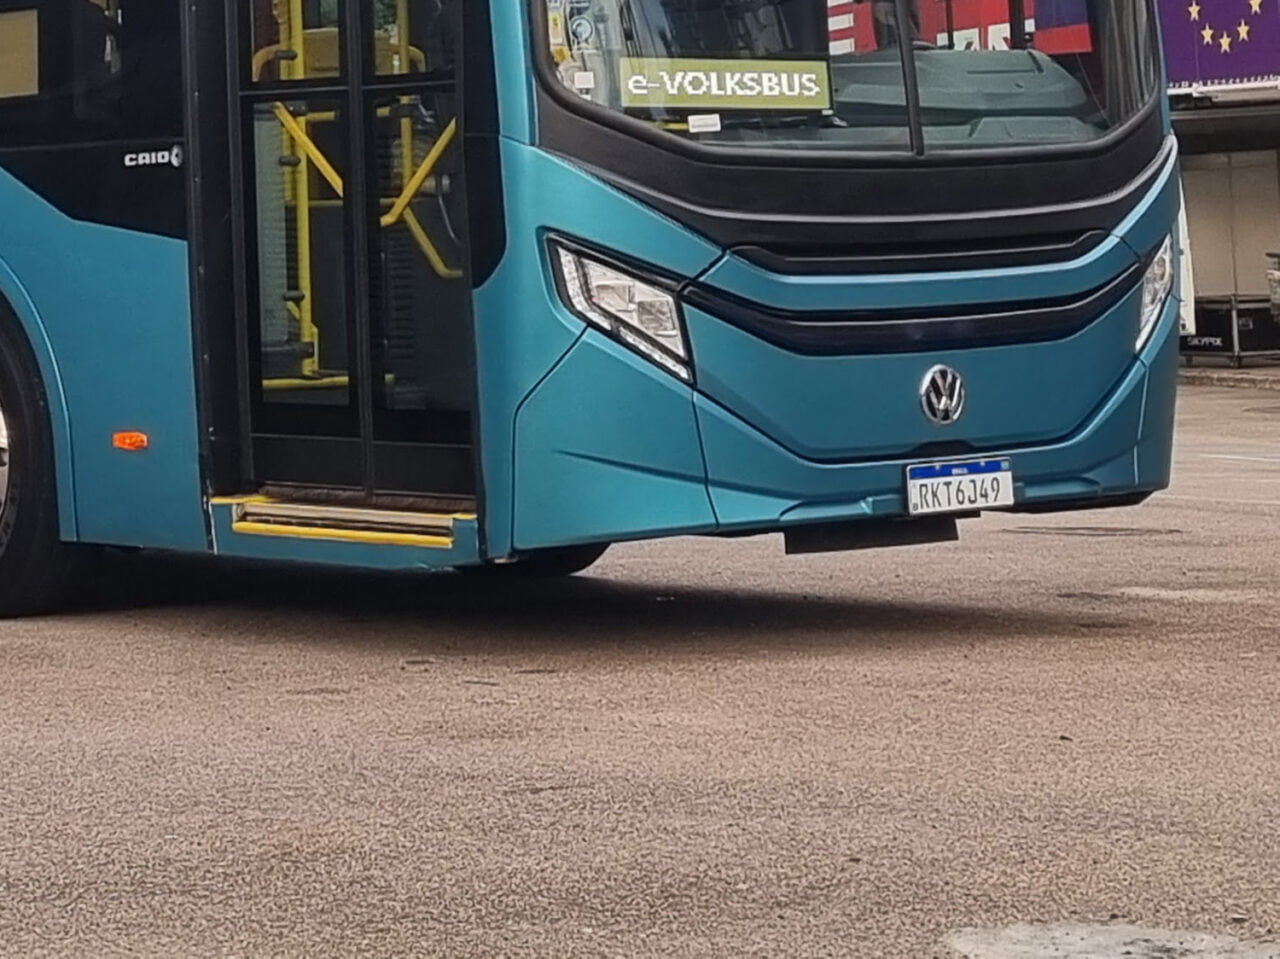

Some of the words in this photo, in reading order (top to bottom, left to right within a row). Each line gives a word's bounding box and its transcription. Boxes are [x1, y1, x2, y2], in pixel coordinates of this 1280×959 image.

[628, 71, 820, 96] e-VOLKSBUS
[124, 151, 170, 166] CAIO
[918, 476, 1000, 510] RKT6J49
